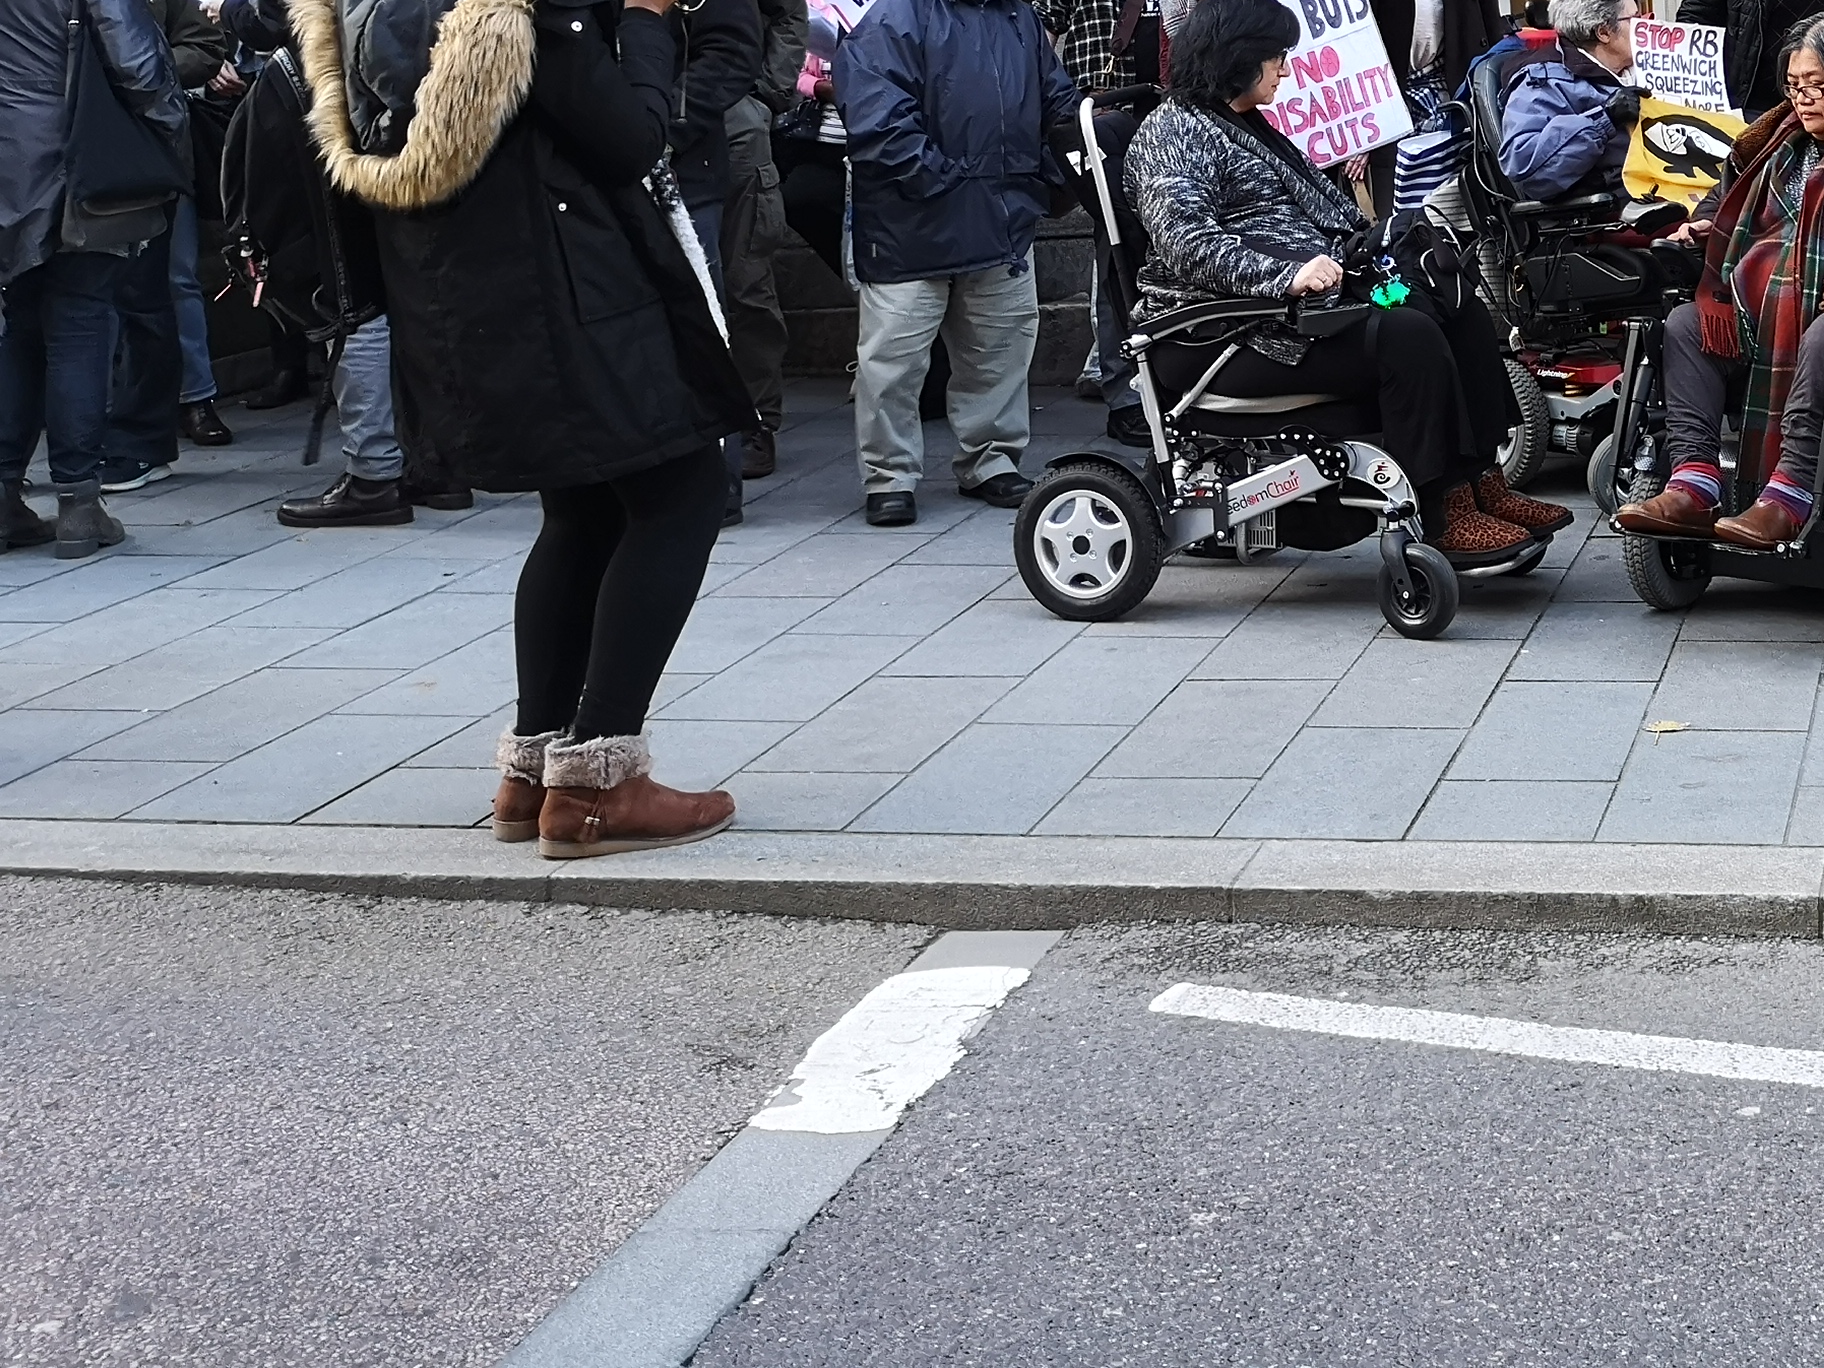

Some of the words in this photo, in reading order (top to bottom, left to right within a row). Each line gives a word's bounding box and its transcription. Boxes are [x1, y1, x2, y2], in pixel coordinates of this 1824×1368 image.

[1634, 21, 1686, 53] STOP
[1689, 28, 1719, 59] RB
[1291, 45, 1340, 90] NO
[1635, 50, 1718, 79] GREENWICH
[1645, 72, 1724, 101] SQUEEZING
[1259, 62, 1394, 137] DISABILITY
[1307, 112, 1381, 164] CUTS
[1226, 471, 1299, 516] eedomChair
